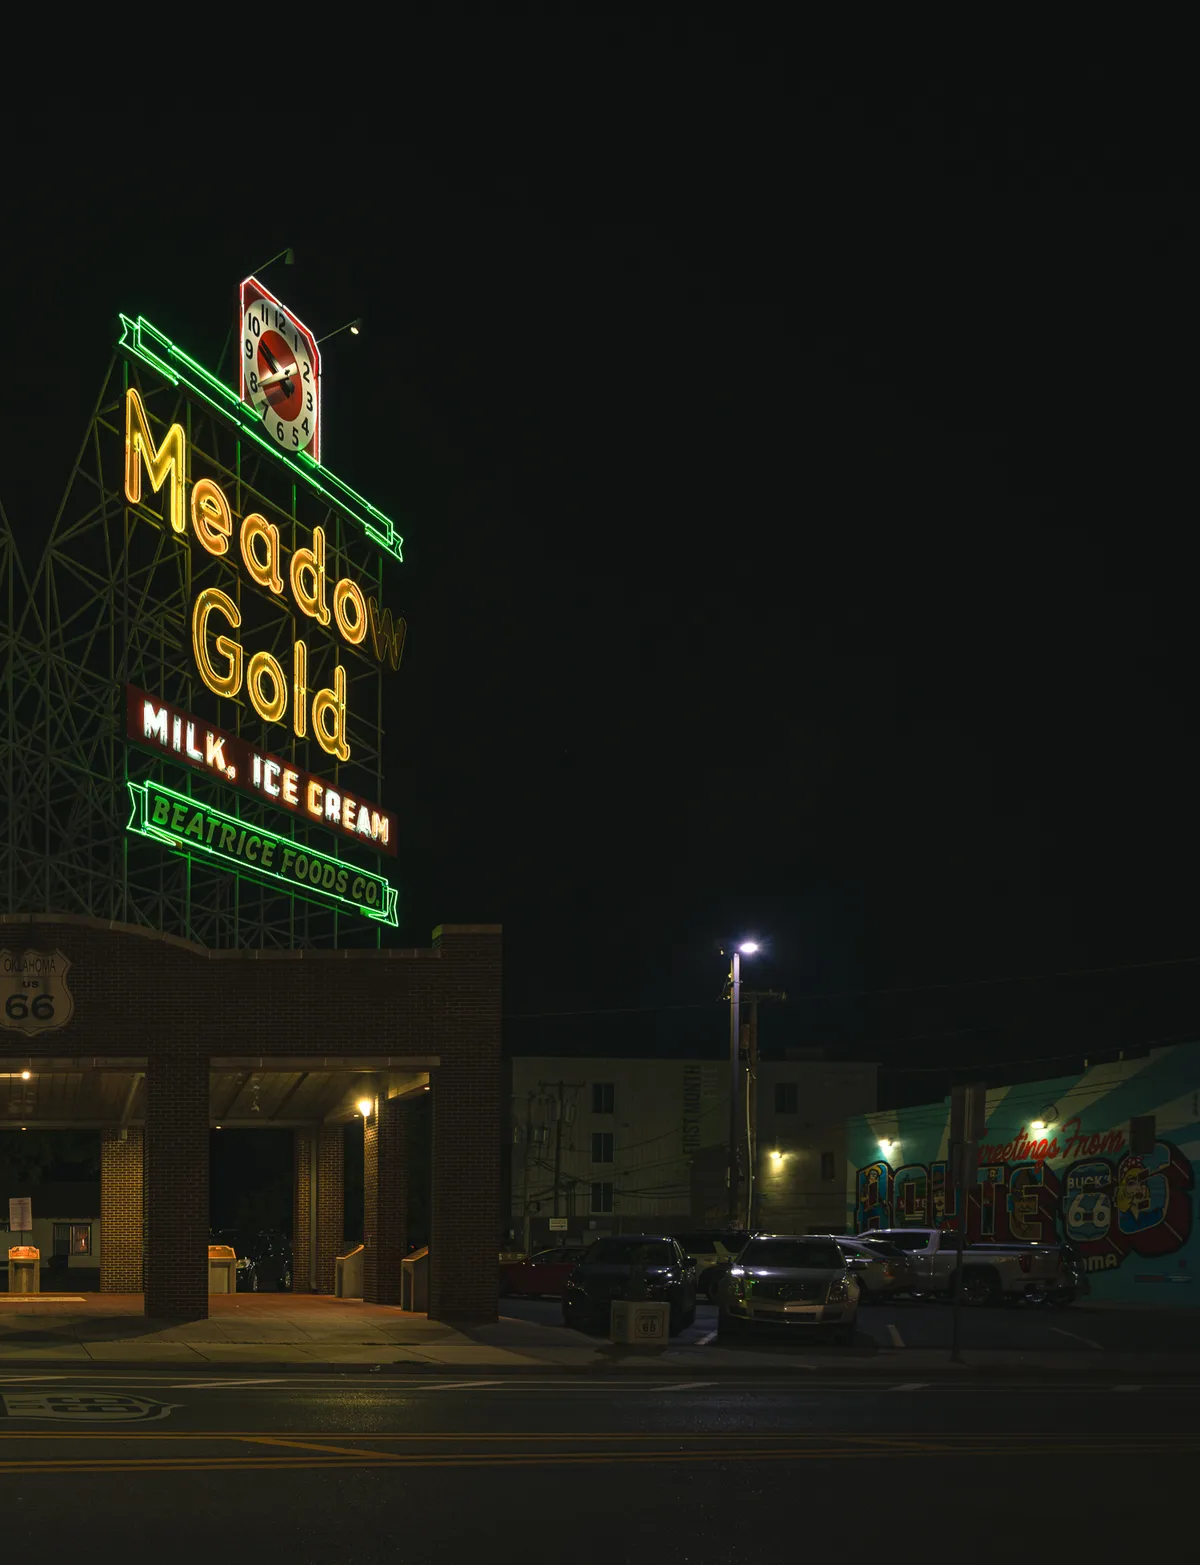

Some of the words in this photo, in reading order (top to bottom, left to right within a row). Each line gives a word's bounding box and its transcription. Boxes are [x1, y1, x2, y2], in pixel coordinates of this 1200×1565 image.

[248, 313, 260, 337] 10
[261, 304, 269, 326] 11
[275, 310, 286, 335] 12
[246, 339, 253, 359] 9
[250, 372, 258, 393] 8
[303, 361, 310, 384] 2
[261, 400, 269, 420] 7
[306, 391, 313, 412] 3
[277, 422, 284, 441] 6
[292, 426, 299, 447] 5
[302, 417, 309, 436] 4
[125, 387, 407, 671] Meadow
[192, 588, 350, 761] Gold
[143, 700, 236, 780] MILK,
[253, 753, 299, 806] ICE
[307, 779, 389, 846] CREAM
[152, 795, 276, 868] BEATRICE
[280, 849, 349, 895] FOODS
[351, 877, 380, 907] CO.
[4, 958, 57, 973] OKLAHOMA
[22, 980, 38, 988] US
[5, 994, 55, 1020] 66
[683, 1065, 700, 1114] MONTH
[683, 1117, 700, 1154] FIRST
[1062, 1117, 1125, 1159] From
[1069, 1194, 1111, 1228] 66
